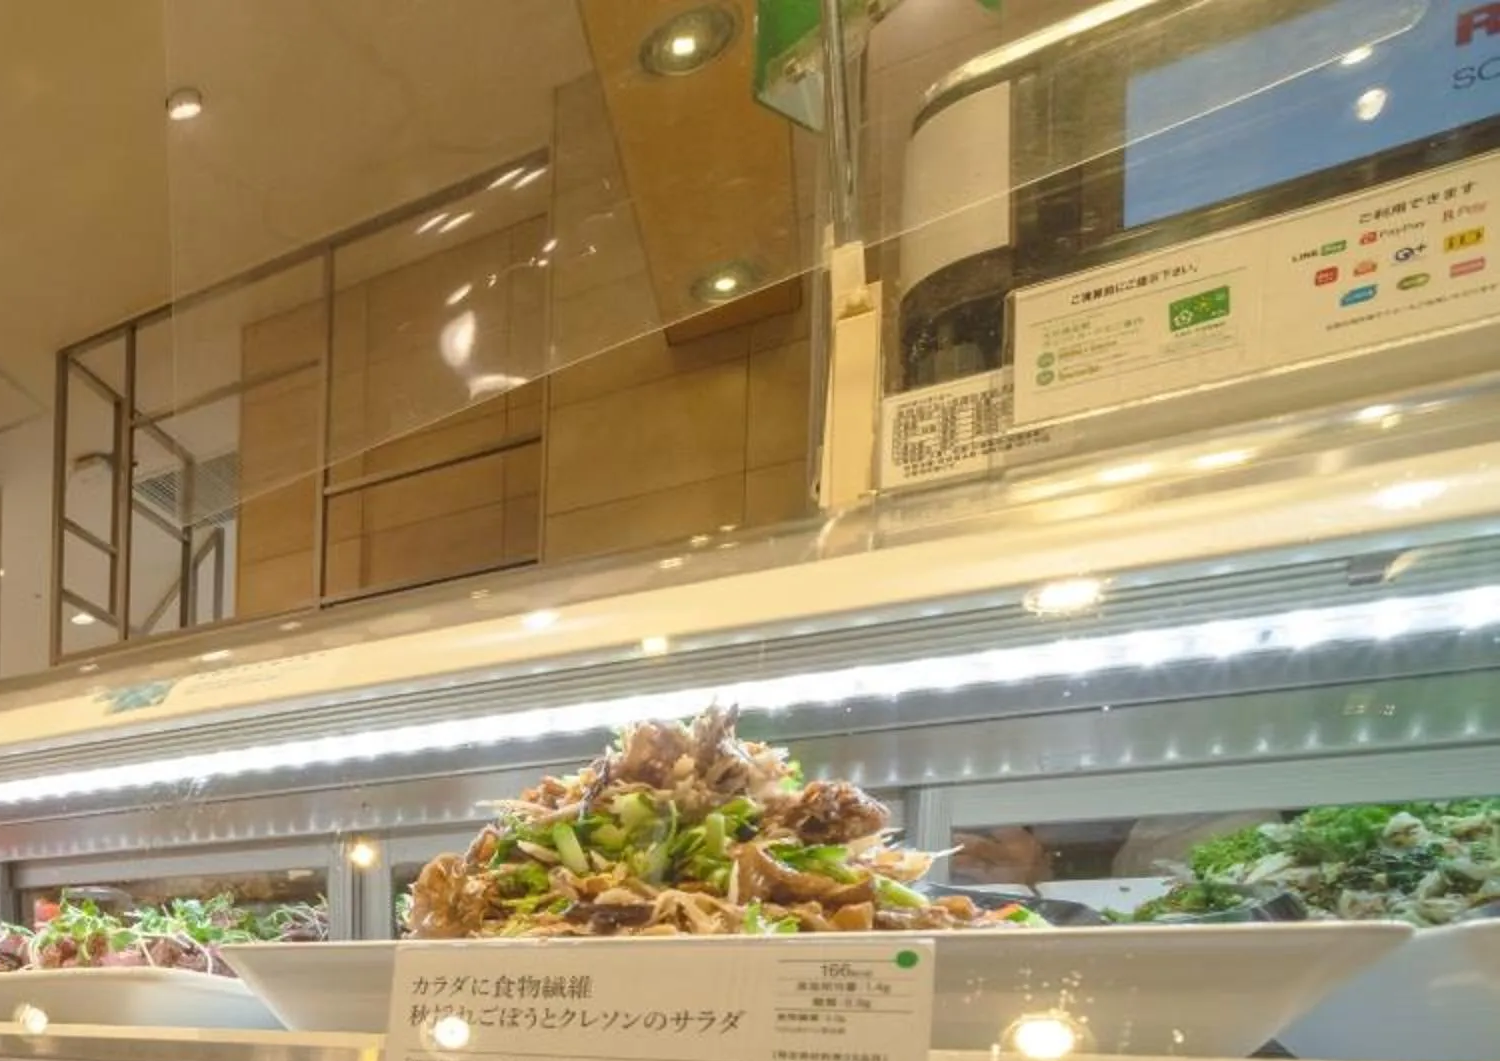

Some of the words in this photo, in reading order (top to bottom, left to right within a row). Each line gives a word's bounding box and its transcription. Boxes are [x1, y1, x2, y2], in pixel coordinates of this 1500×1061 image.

[412, 974, 592, 1000] カラダに食物繊維
